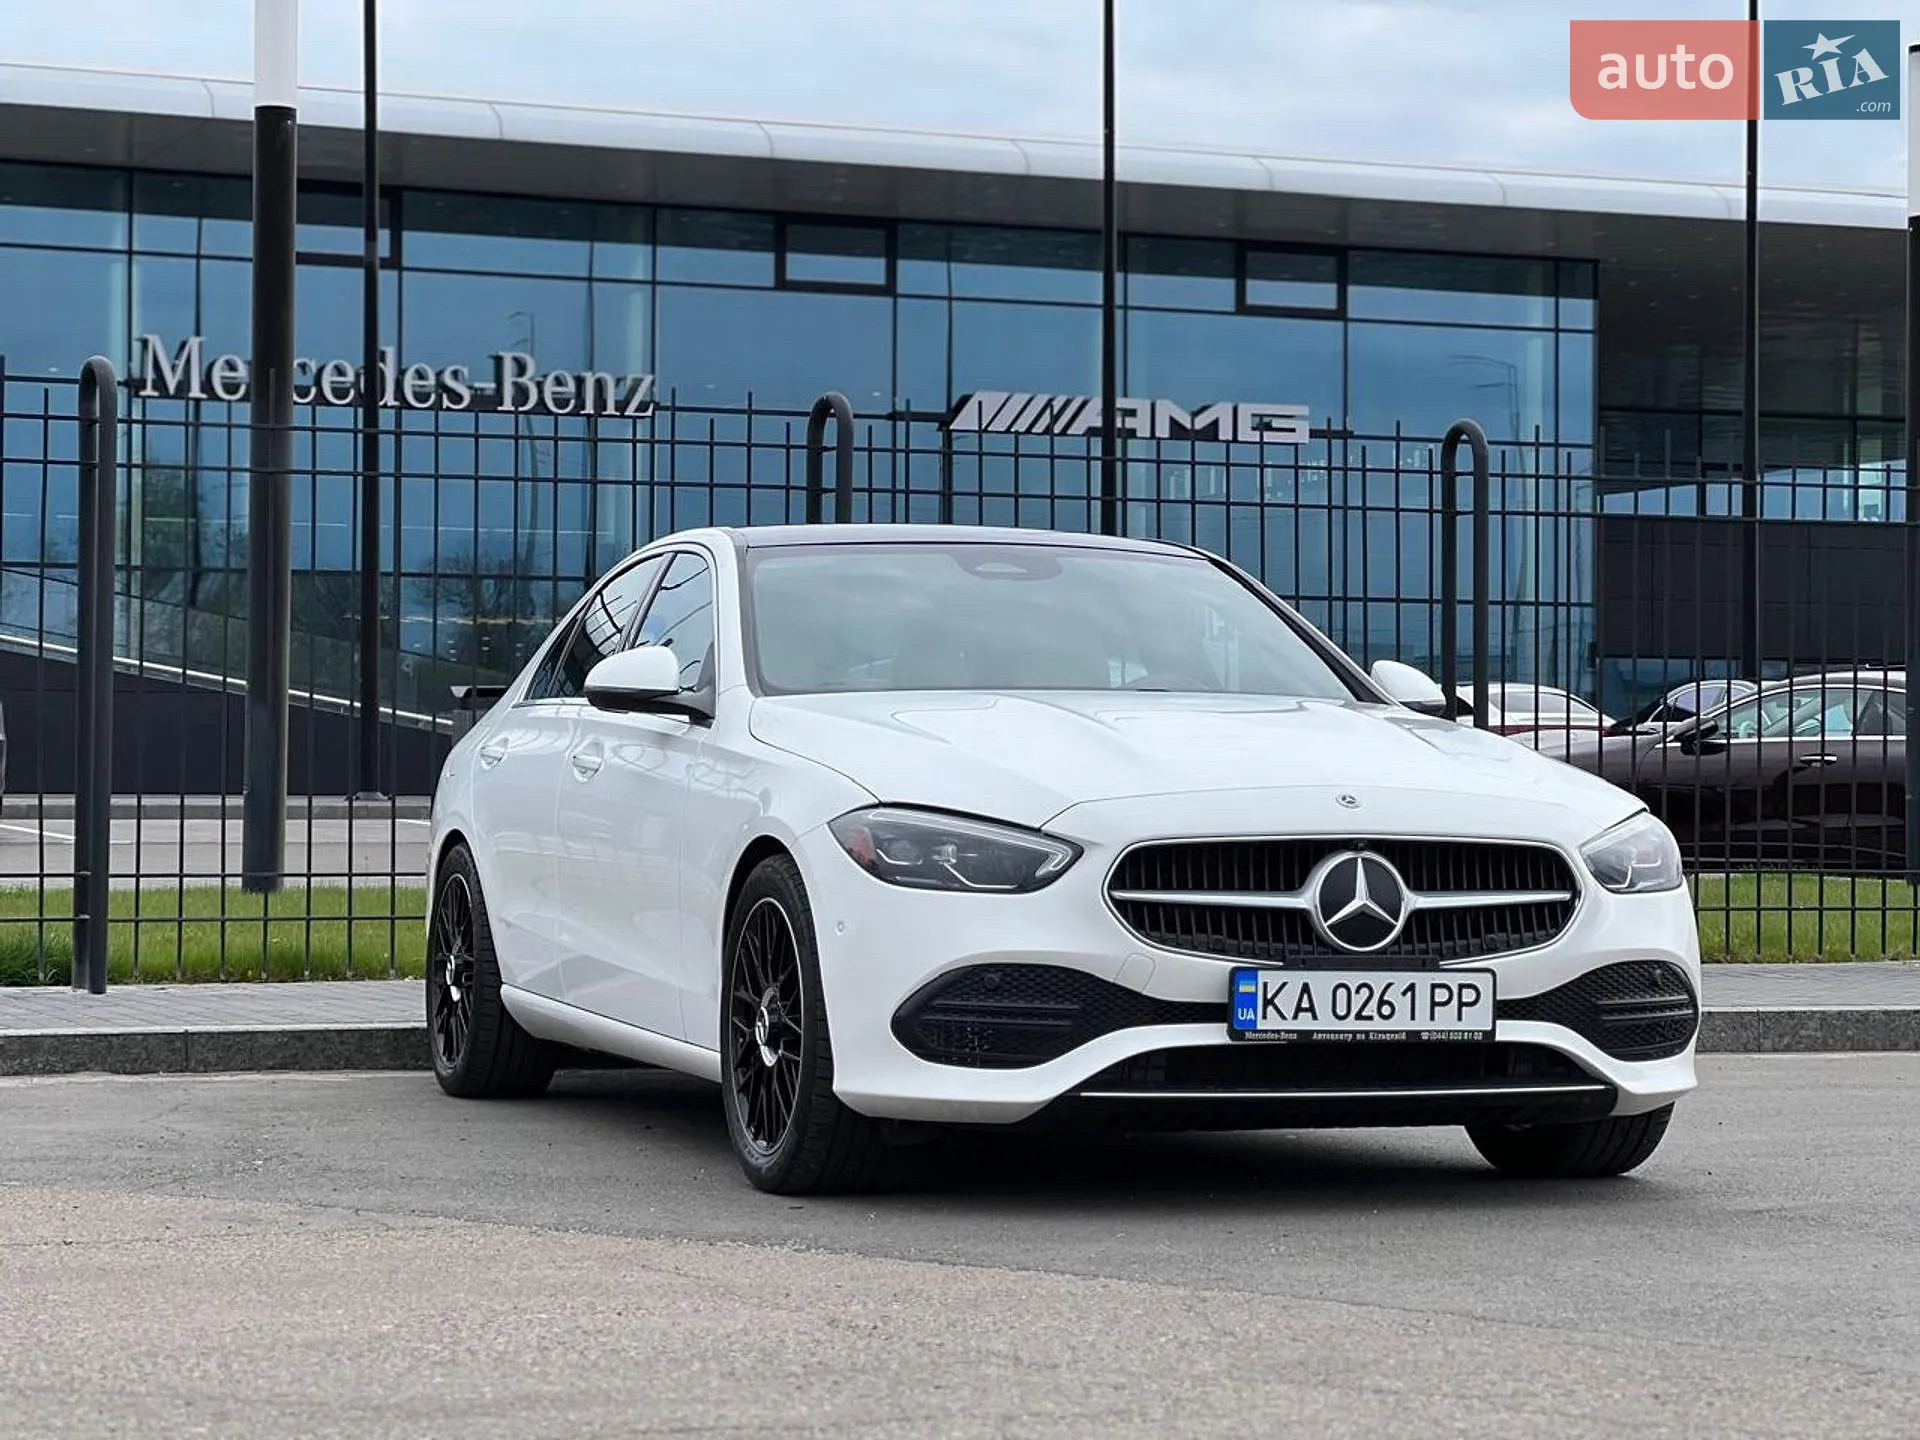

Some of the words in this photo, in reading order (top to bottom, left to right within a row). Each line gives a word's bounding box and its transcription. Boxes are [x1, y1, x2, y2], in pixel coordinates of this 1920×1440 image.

[139, 334, 656, 418] Mecedes-Benz
[1237, 1008, 1256, 1021] UA
[1261, 981, 1319, 1022] KA
[1331, 981, 1417, 1022] 0261
[1429, 982, 1482, 1022] PP
